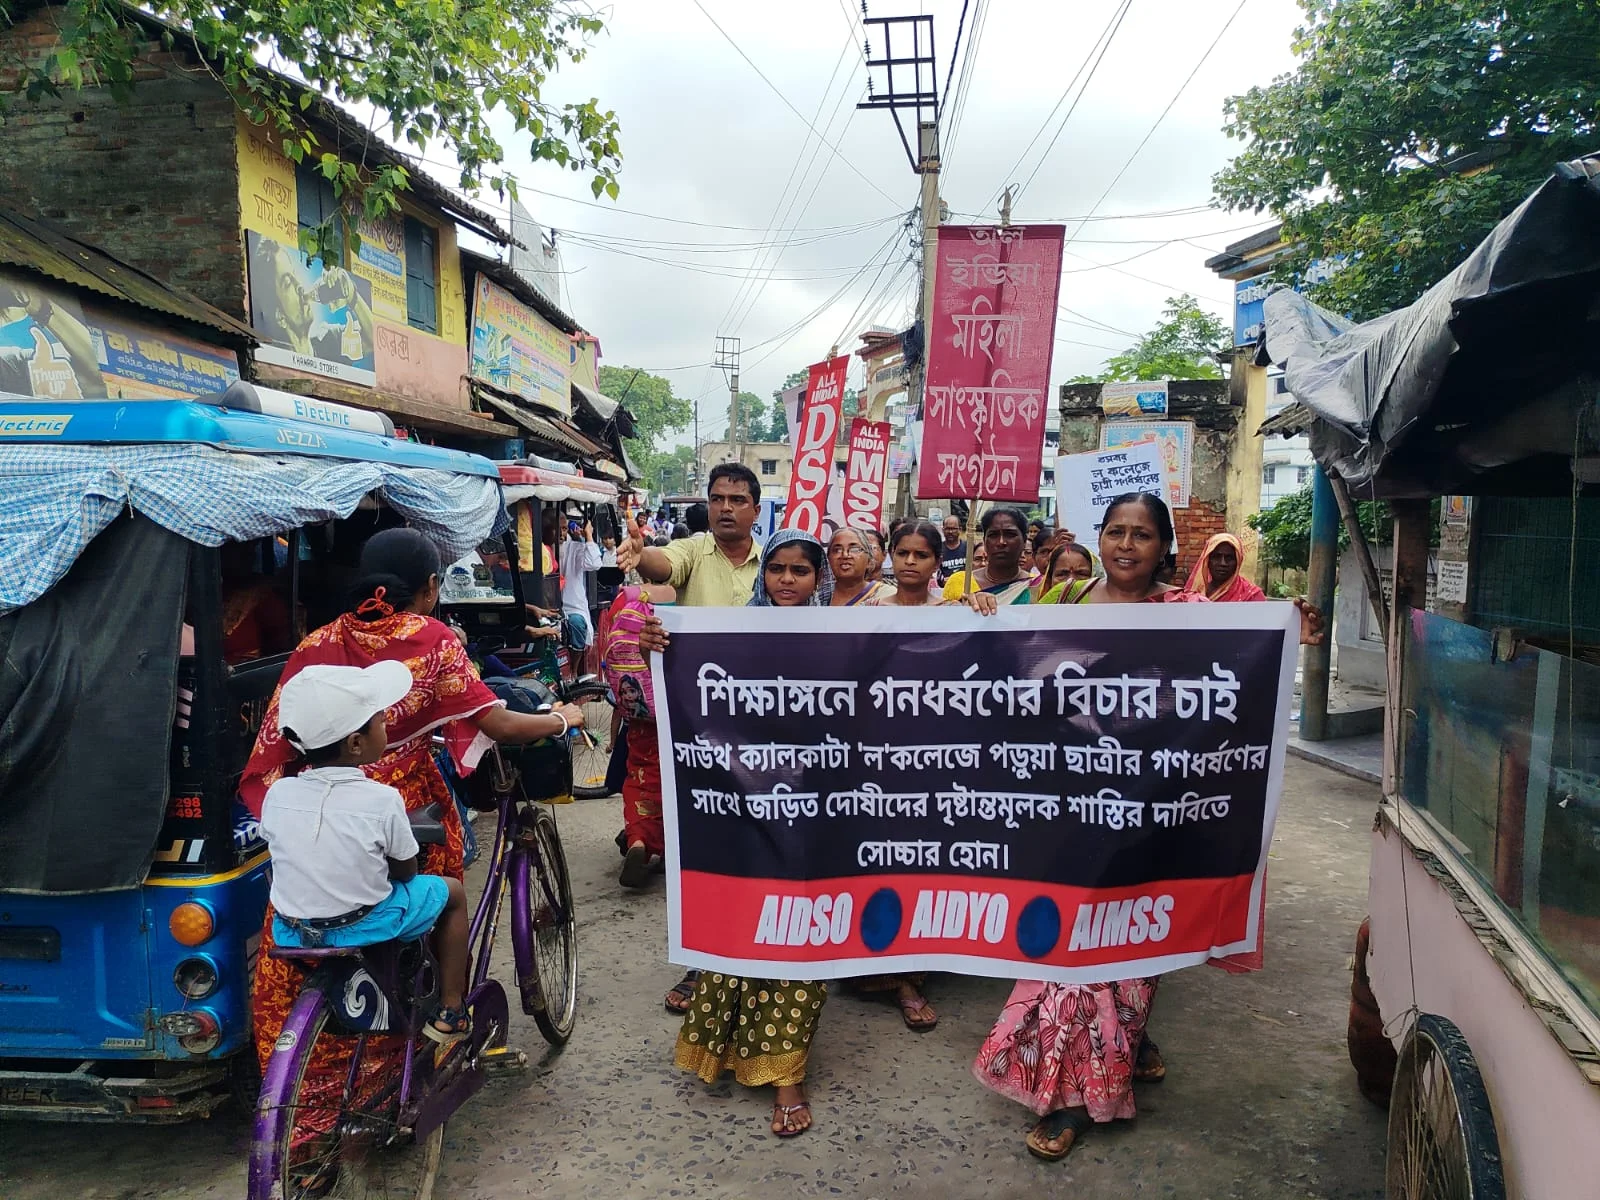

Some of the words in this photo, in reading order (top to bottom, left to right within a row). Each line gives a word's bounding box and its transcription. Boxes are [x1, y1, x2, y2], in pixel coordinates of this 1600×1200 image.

[968, 227, 1026, 248] অল
[946, 254, 1040, 289] ইন্ডিয়া
[951, 295, 1024, 364] মহিলা
[810, 385, 838, 404] INDIA
[816, 372, 837, 389] ALL
[0, 420, 63, 430] lectric
[294, 399, 350, 425] Electric
[853, 436, 884, 451] INDIA
[859, 425, 881, 438] ALL
[937, 433, 1020, 499] সংগঠন
[696, 662, 858, 717] শিক্ষাঙ্গনে
[868, 662, 1043, 718] গনধর্ষণের
[1053, 660, 1160, 719] বিচার
[1171, 662, 1240, 723] চাই
[674, 735, 732, 771] সাউথ
[738, 733, 851, 772] ক্যালকাটা
[988, 741, 1057, 780] পড়ুয়া
[1063, 736, 1142, 776] ছাত্রীর
[1150, 739, 1268, 779] গণধর্ষণের
[691, 788, 740, 816] সাথে
[745, 782, 819, 827] জড়িত
[825, 782, 930, 818] দোষীদের
[935, 782, 1060, 829] দৃষ্টান্তমূলক
[1066, 788, 1145, 830] শাস্তির
[1151, 791, 1232, 828] দাবিতে
[856, 839, 941, 868] সোচ্চার
[753, 892, 854, 947] AIDSO
[908, 889, 1010, 944] AIDYO
[1067, 894, 1175, 952] AIMSS
